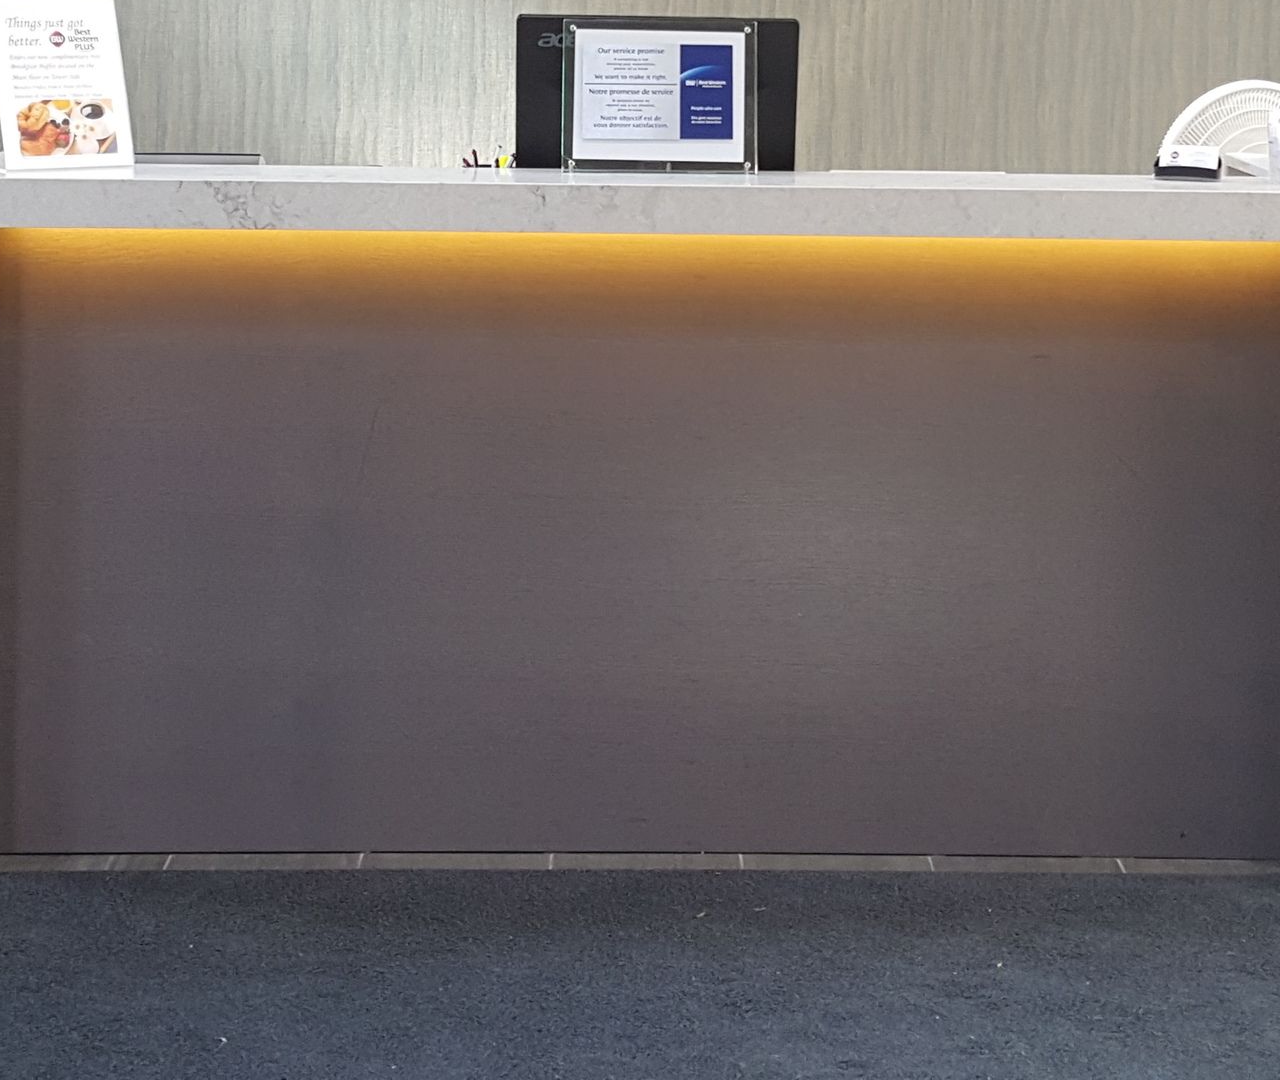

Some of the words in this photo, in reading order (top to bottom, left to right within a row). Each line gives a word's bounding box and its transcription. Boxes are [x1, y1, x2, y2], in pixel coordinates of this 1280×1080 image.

[4, 16, 42, 32] Things
[43, 19, 64, 31] just
[67, 19, 84, 31] got
[74, 28, 92, 36] Best
[8, 34, 42, 47] better.
[67, 35, 99, 43] Western
[637, 47, 665, 55] promise
